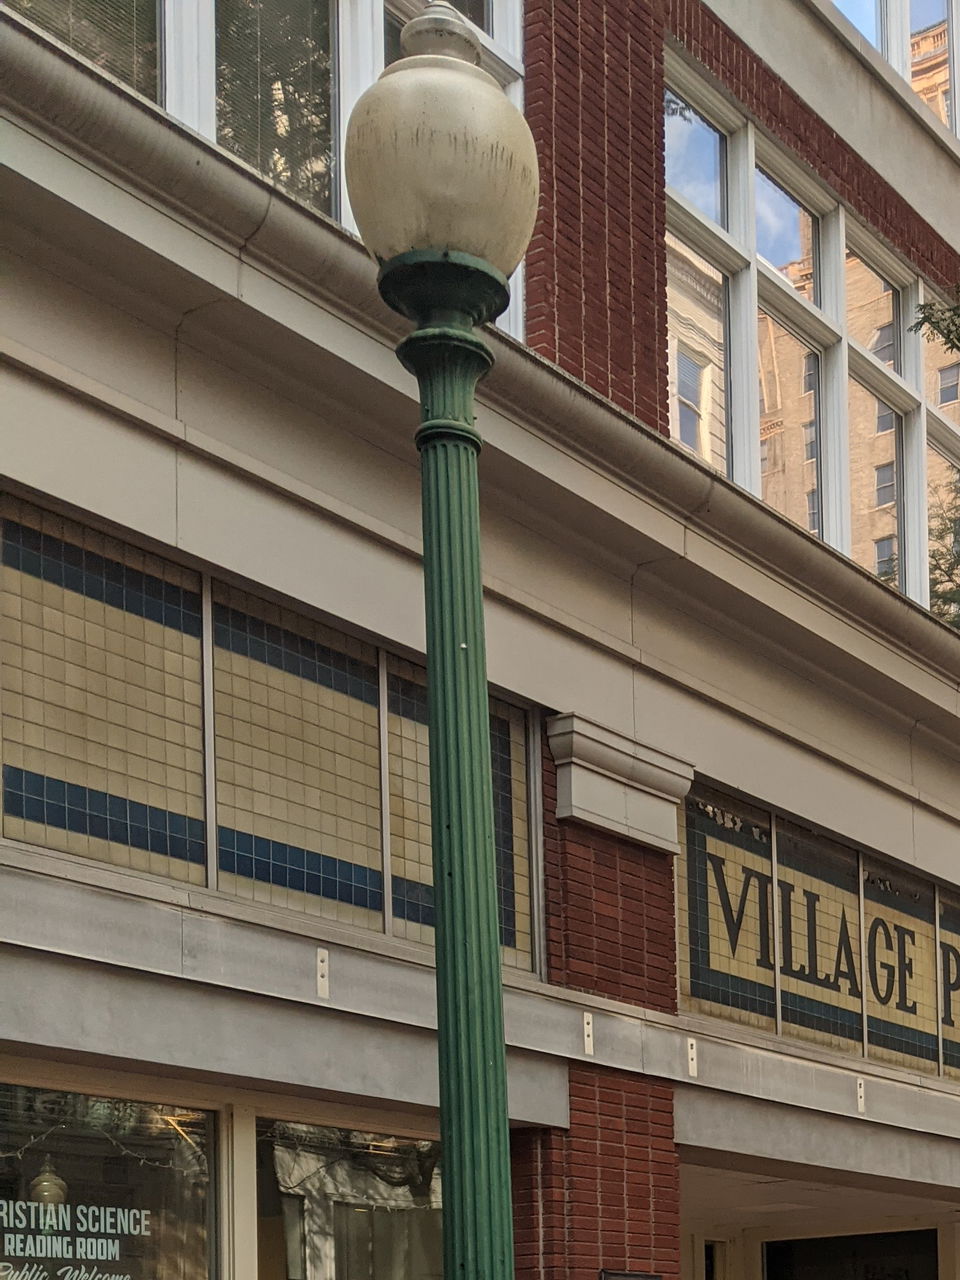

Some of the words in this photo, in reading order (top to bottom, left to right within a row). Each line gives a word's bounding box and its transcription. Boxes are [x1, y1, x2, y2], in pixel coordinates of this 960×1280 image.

[707, 853, 917, 1015] VILLAGE
[76, 1204, 151, 1236] SCIENCE
[4, 1233, 73, 1259] READING
[76, 1237, 120, 1260] ROOM
